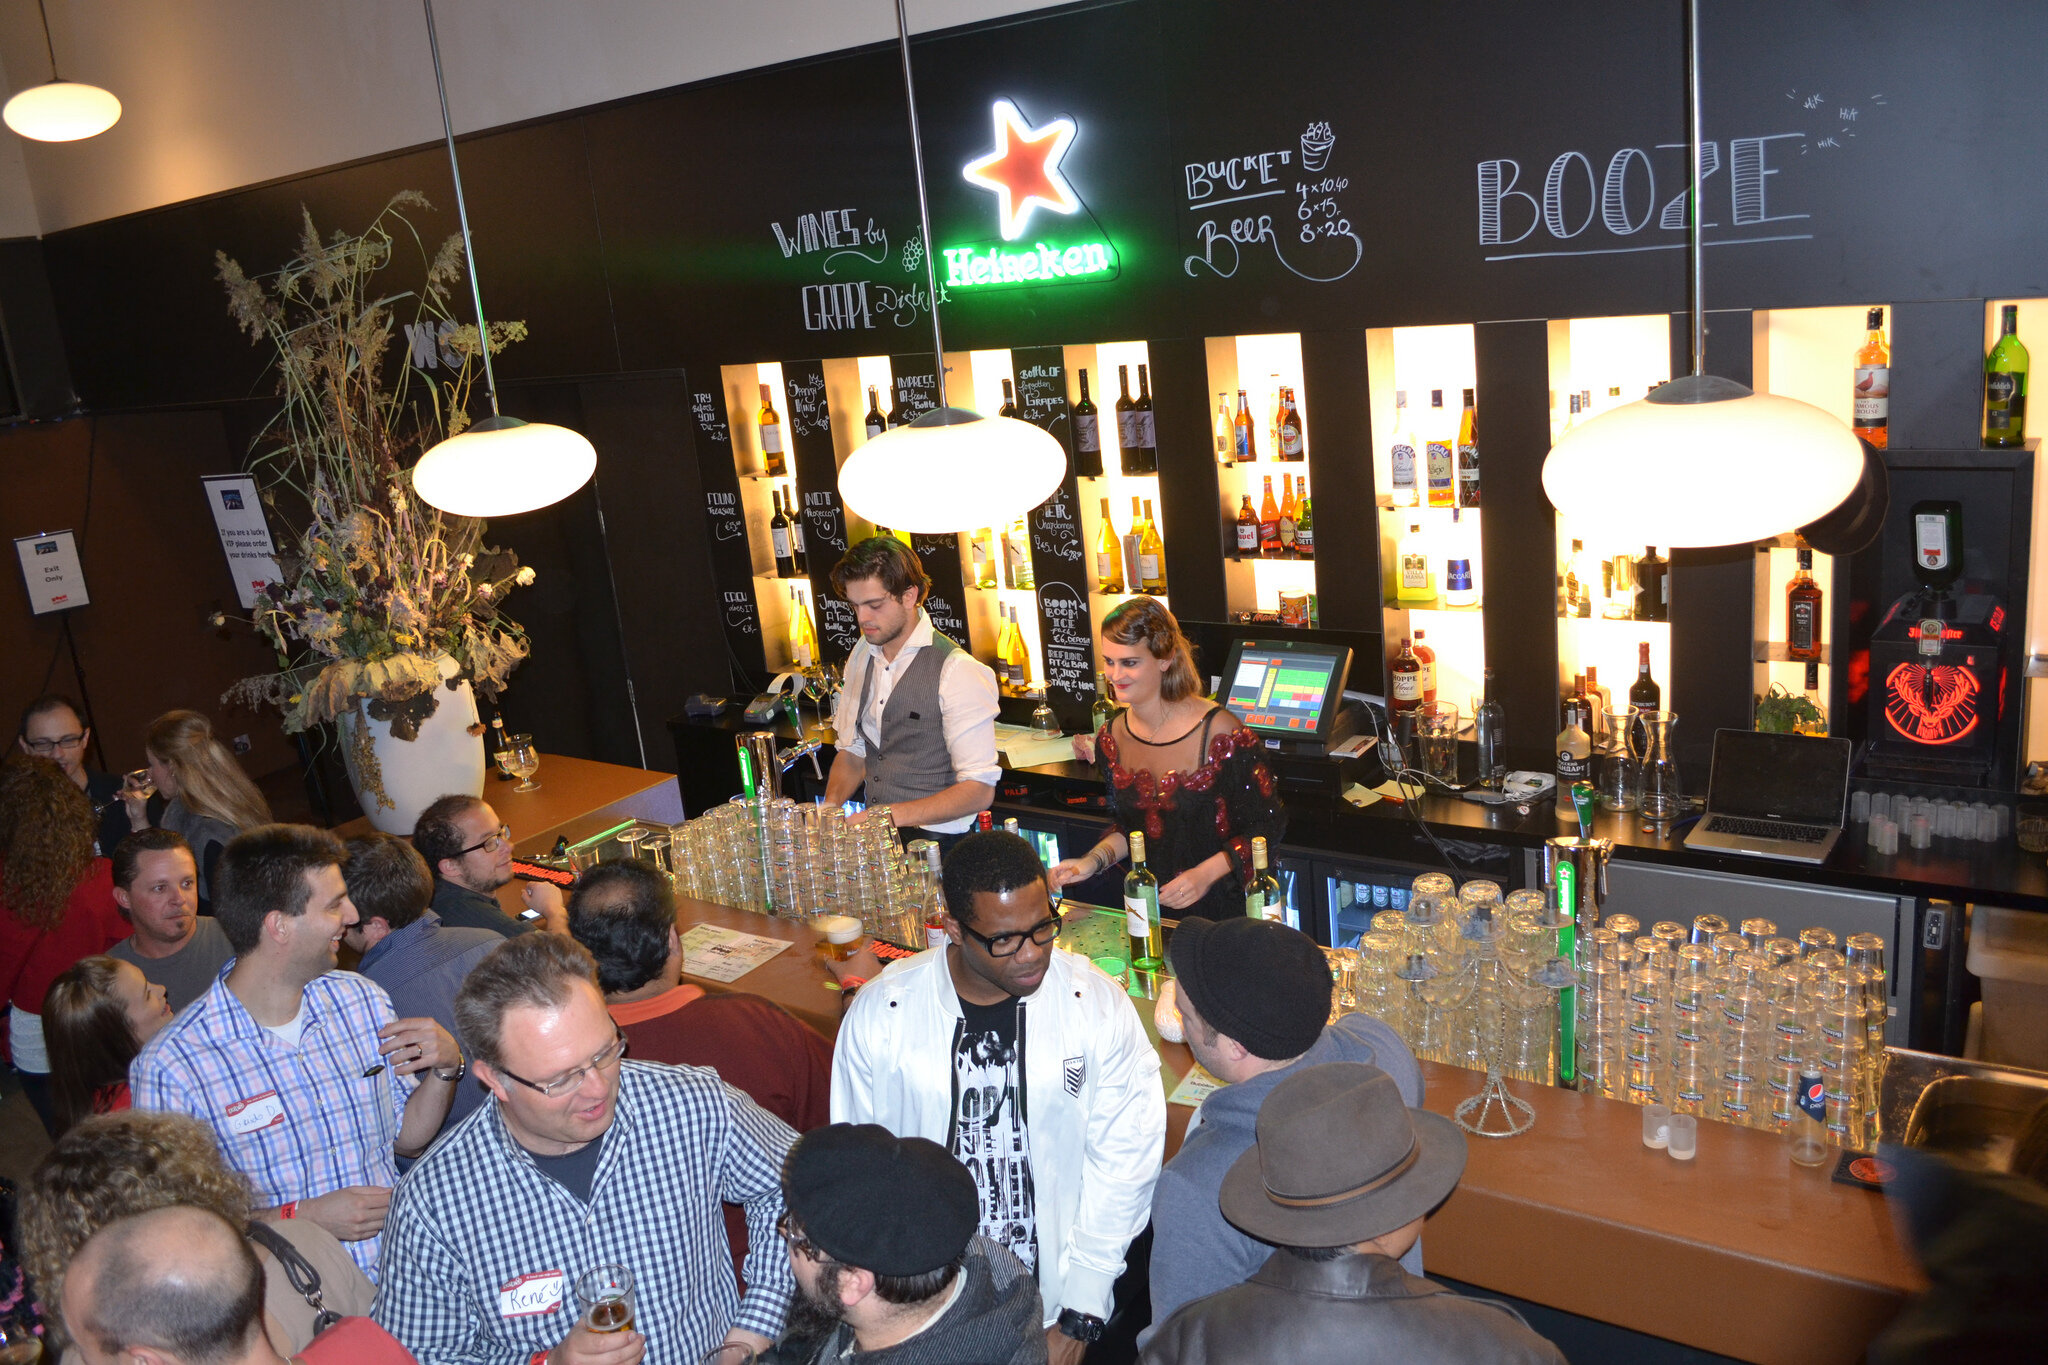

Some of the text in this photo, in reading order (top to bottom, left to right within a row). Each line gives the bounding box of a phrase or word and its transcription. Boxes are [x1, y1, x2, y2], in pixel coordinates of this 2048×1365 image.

[1185, 150, 1293, 200] BUCKET
[1477, 133, 1811, 246] BOOZE
[771, 208, 861, 258] WINES
[942, 242, 1110, 287] Heineken
[801, 281, 876, 331] GRAPE
[1020, 364, 1048, 380] Bottle
[896, 374, 936, 389] IMPRESS
[694, 393, 712, 403] TRY
[1025, 394, 1064, 411] GRAPES
[707, 492, 736, 506] FOUND
[804, 491, 833, 506] NOT
[1238, 531, 1254, 540] uvel
[44, 565, 60, 573] Exit
[45, 575, 64, 583] Only
[1044, 597, 1078, 610] BOOM
[1045, 607, 1079, 619] BOOM
[1052, 617, 1076, 629] ICE
[1047, 649, 1083, 661] REFUND
[1071, 660, 1089, 670] BAR
[1810, 1101, 1826, 1110] peps
